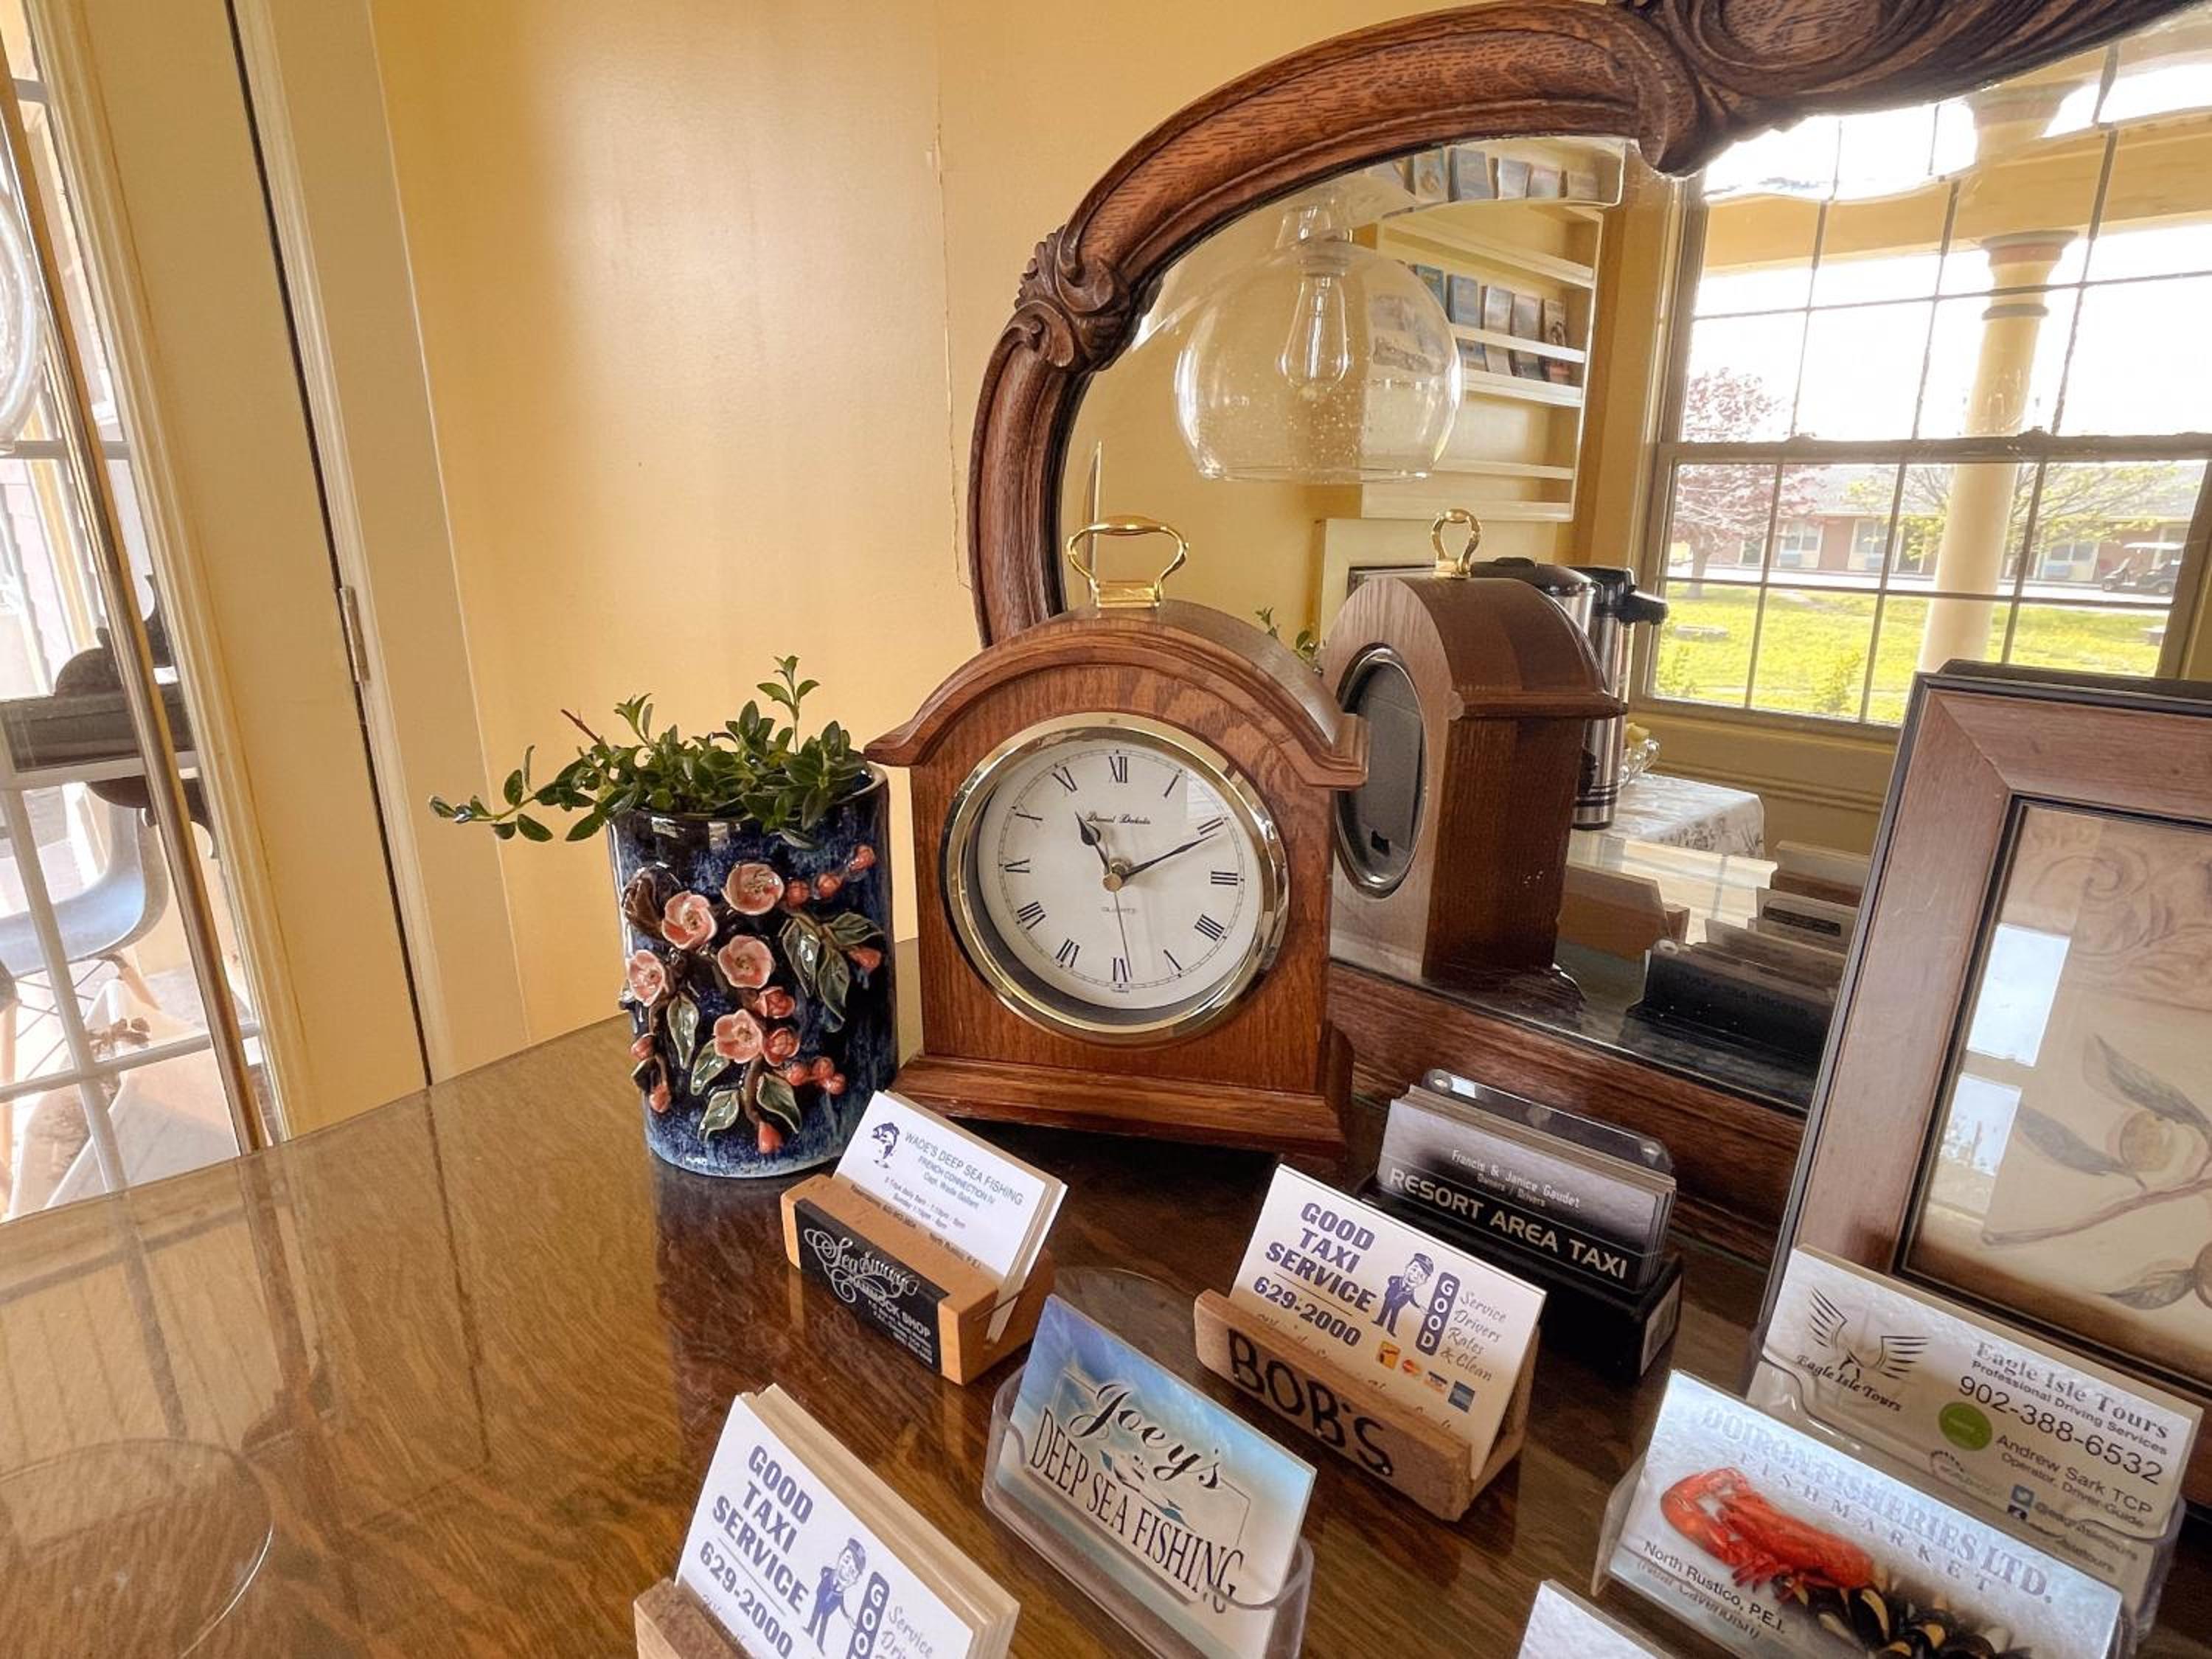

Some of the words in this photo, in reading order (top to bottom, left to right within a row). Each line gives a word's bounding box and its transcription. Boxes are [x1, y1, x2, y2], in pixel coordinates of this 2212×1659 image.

[938, 1150, 964, 1169] DEEP
[963, 1164, 983, 1182] SEA
[984, 1176, 1024, 1206] FISHING
[1452, 1149, 1486, 1172] Francis
[1490, 1164, 1500, 1178] &
[1506, 1170, 1538, 1192] Janice
[1543, 1183, 1580, 1208] Gaudet
[1300, 1202, 1375, 1252] GOOD
[1301, 1228, 1361, 1274] TAXI
[1390, 1167, 1485, 1220] RESORT
[1489, 1209, 1559, 1252] AREA
[1568, 1239, 1627, 1280] TAXI
[1253, 1276, 1362, 1347] 629-2000
[1265, 1242, 1377, 1313] SERVICE
[1420, 1279, 1455, 1348] GOOD
[1460, 1291, 1507, 1324] Service
[1447, 1326, 1486, 1355] Rates
[1454, 1309, 1503, 1343] Drivers
[1228, 1328, 1395, 1477] BOB'S
[1456, 1352, 1492, 1381] Clean
[1797, 1354, 1834, 1380] Eagle
[1835, 1374, 1861, 1392] Isle
[1863, 1385, 1902, 1411] Tours
[1976, 1341, 2037, 1382] Eagle
[2047, 1369, 2089, 1403] Isle
[2098, 1392, 2170, 1440] Tours
[1068, 1383, 1222, 1490] Joey's
[1959, 1375, 2163, 1486] 902-388-6532
[1972, 1360, 2052, 1405] Professional
[2054, 1396, 2104, 1430] Driving
[2107, 1420, 2169, 1457] Services
[748, 1444, 814, 1525] GOOD
[1029, 1408, 1091, 1498] DEEP
[1087, 1472, 1128, 1537] SEA
[1132, 1508, 1244, 1614] FISHING
[1997, 1435, 2061, 1472] Andrew
[2065, 1467, 2106, 1496] Sark
[2112, 1488, 2153, 1513] TCP
[742, 1480, 797, 1554] TAXI
[1812, 1458, 1978, 1561] FISHERIES
[1980, 1540, 2053, 1604] LTD.
[712, 1496, 810, 1614] SERVICE
[1644, 1540, 1682, 1572] North
[1686, 1565, 1744, 1611] Rustico,
[1749, 1602, 1786, 1634] P.E.I.
[700, 1541, 793, 1659] 629-2000
[851, 1583, 886, 1659] GOO
[888, 1605, 933, 1658] Service
